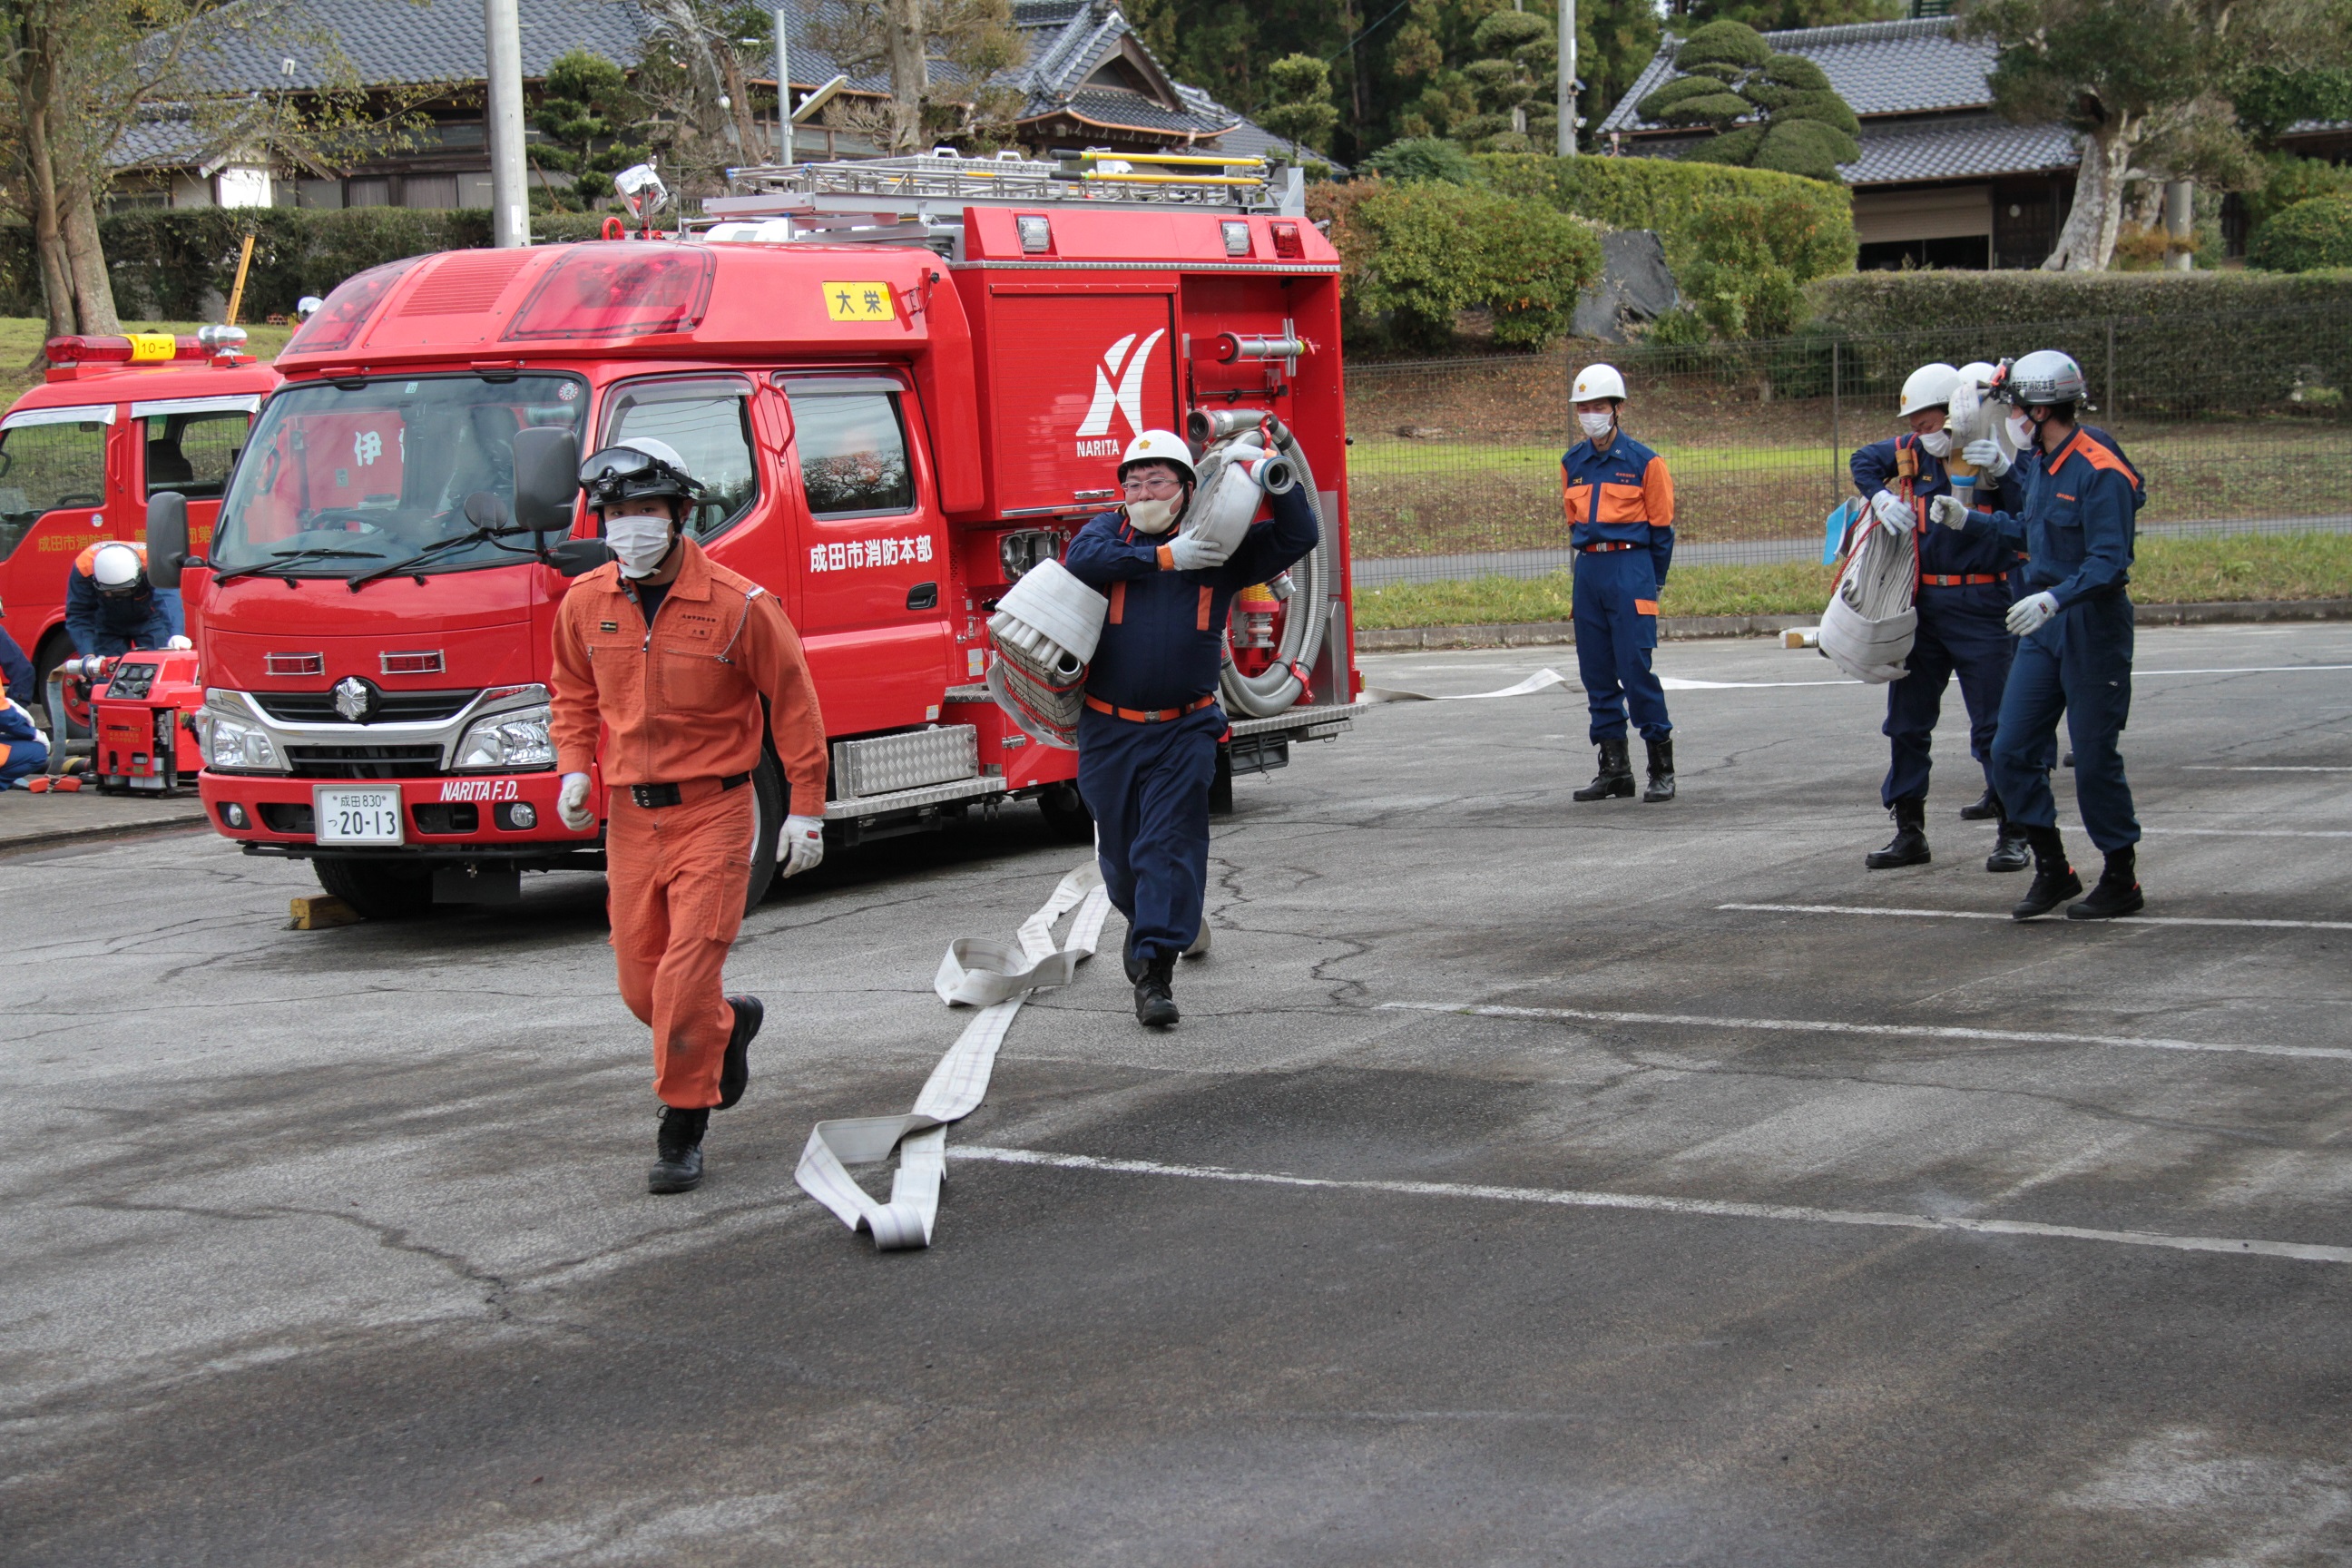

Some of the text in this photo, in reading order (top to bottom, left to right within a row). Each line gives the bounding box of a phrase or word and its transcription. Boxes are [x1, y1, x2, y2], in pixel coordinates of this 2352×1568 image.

[836, 290, 882, 314] 大栄
[142, 342, 172, 354] 10-1
[1076, 439, 1120, 457] NARITA
[810, 534, 933, 573] 成田市消防本部
[440, 780, 519, 801] NARITA F.D.
[339, 810, 397, 835] 20-13
